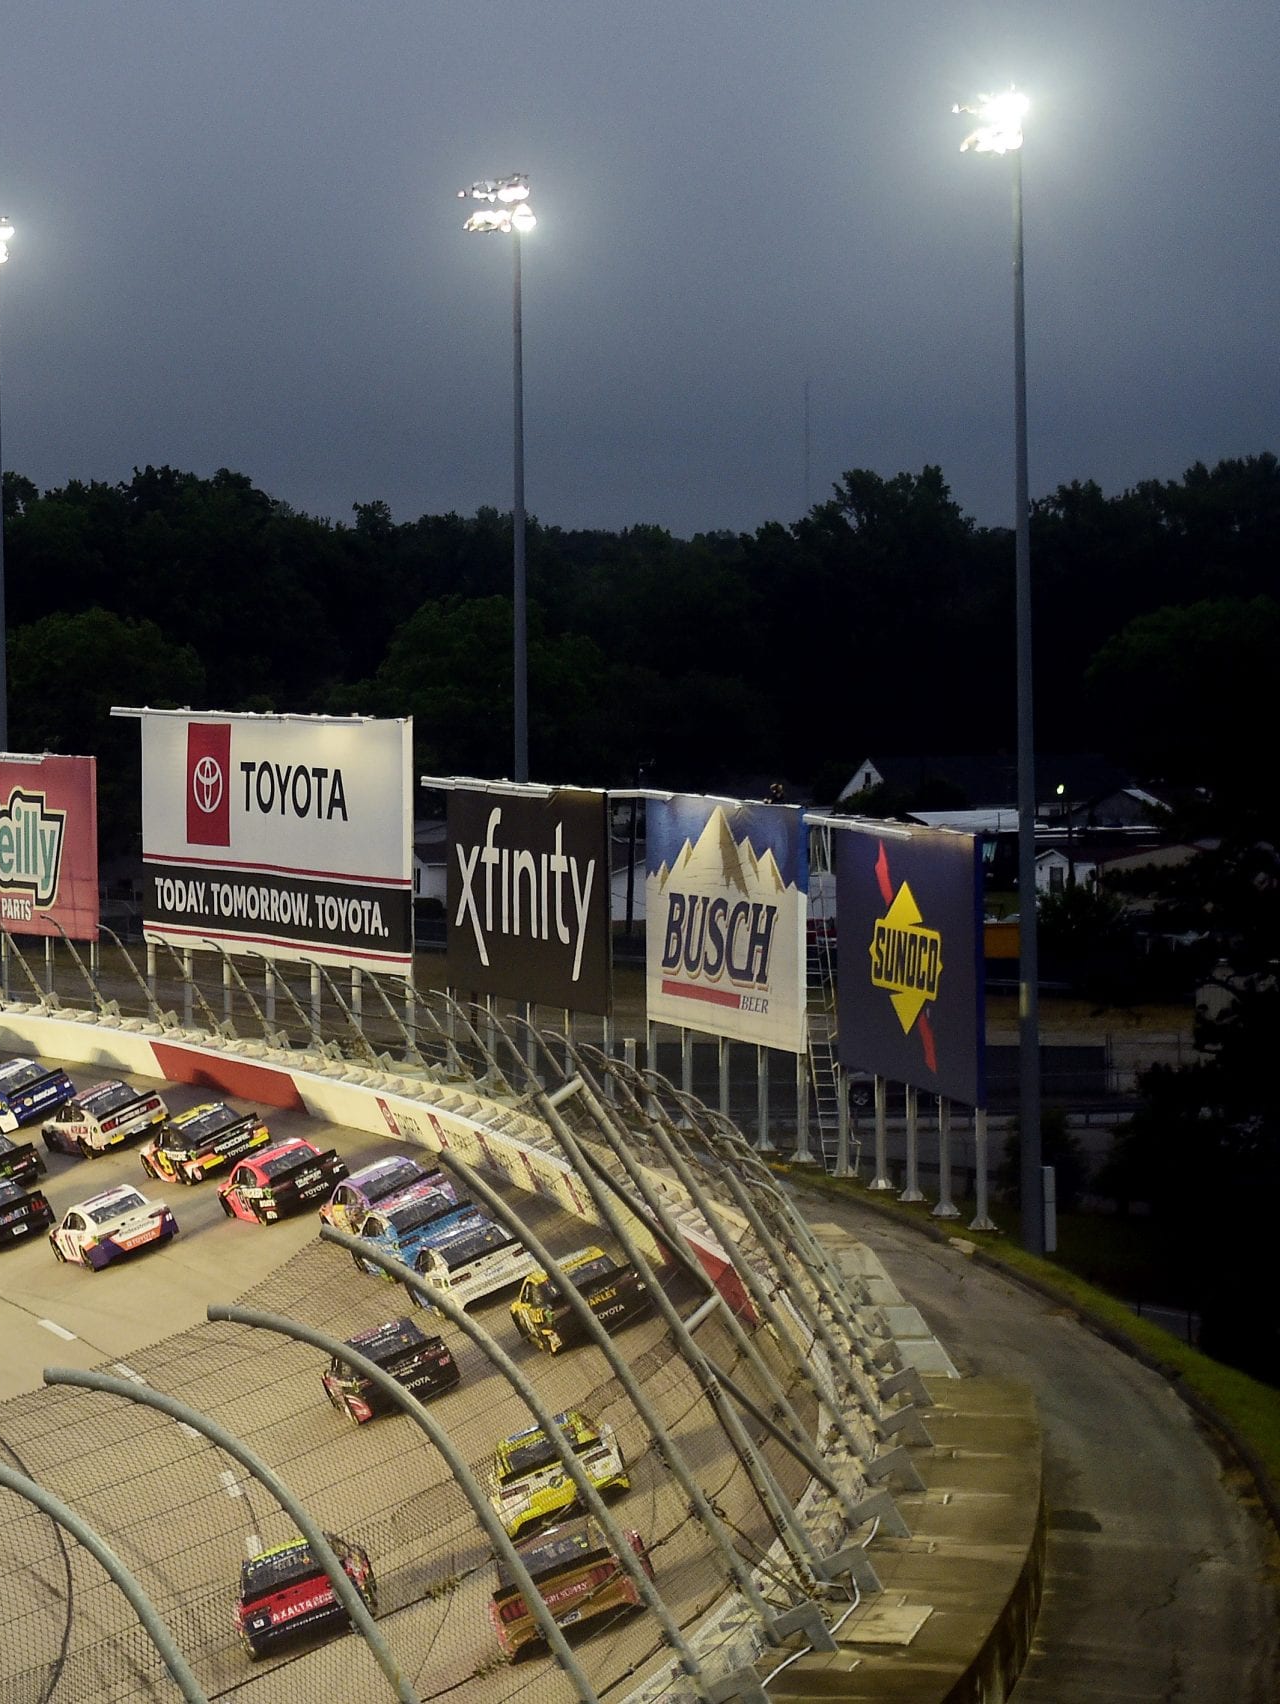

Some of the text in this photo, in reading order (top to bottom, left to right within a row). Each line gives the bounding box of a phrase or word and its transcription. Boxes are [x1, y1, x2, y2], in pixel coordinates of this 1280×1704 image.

[240, 760, 349, 821] TOYOTA
[455, 807, 596, 982] xfinity
[1, 897, 31, 921] PARTS
[154, 877, 389, 938] TODAY. TOMORROW. TOYOTA.
[662, 892, 778, 990] BUSCH
[874, 926, 940, 993] SUNOCO
[741, 995, 769, 1014] BEER
[214, 1131, 250, 1153] PROCORE
[227, 1144, 250, 1158] TOYOTA
[304, 1182, 330, 1198] TOYOTA
[588, 1287, 618, 1307] ANLEY
[402, 1375, 431, 1392] OYOTA
[272, 1597, 314, 1622] AXALTA
